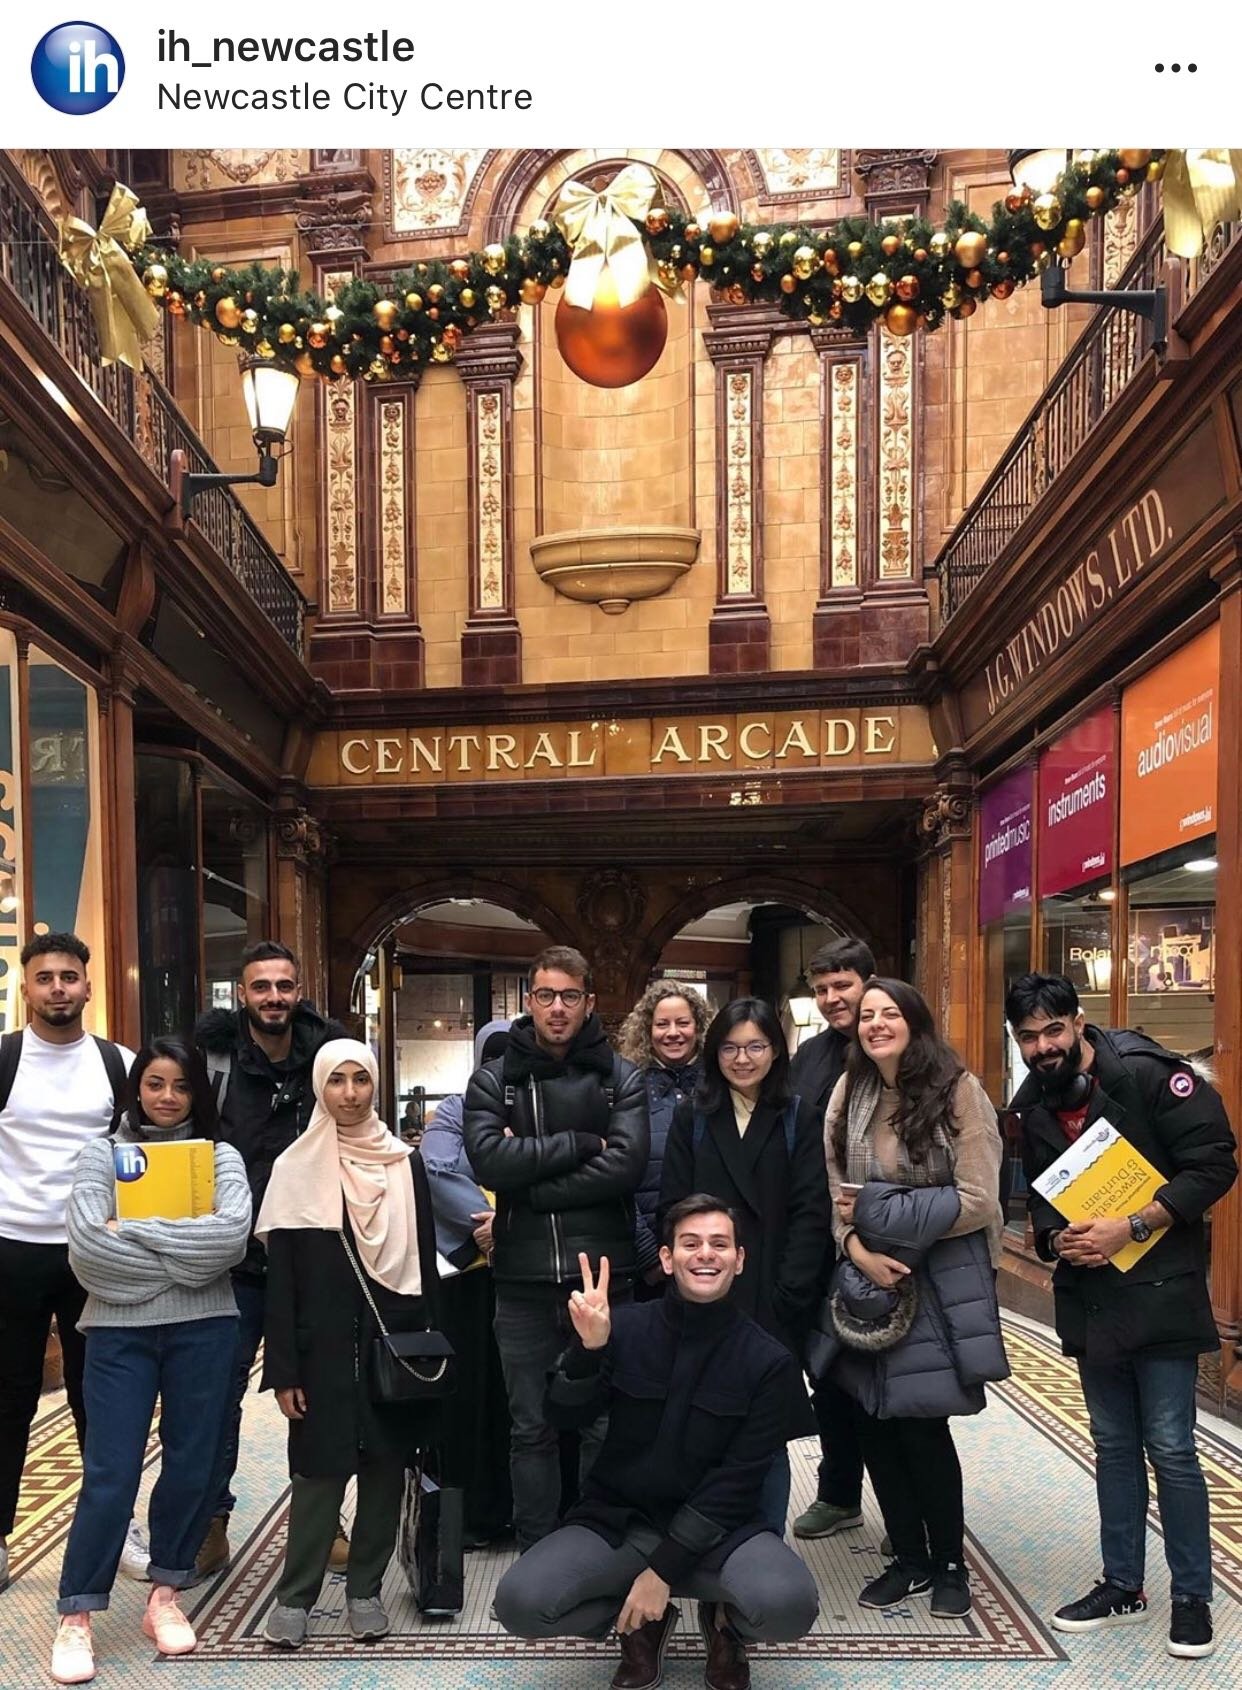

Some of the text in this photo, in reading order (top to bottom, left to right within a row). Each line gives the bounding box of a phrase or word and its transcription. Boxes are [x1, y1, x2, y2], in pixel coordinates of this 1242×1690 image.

[340, 715, 898, 776] CENTRAL ARCADE
[1047, 770, 1106, 828] instruments
[122, 1149, 146, 1174] ih
[1080, 1167, 1130, 1211] Durham
